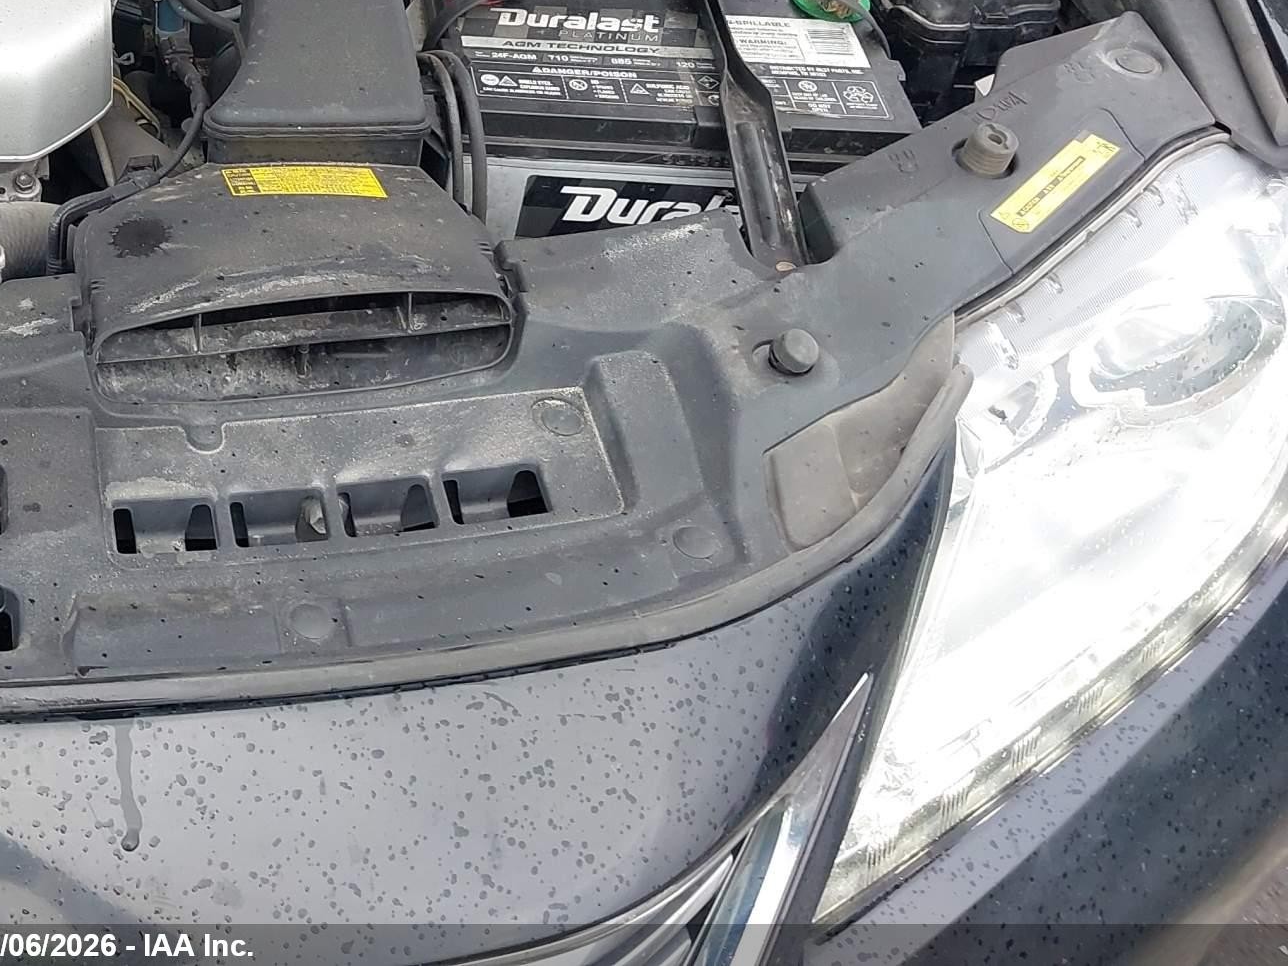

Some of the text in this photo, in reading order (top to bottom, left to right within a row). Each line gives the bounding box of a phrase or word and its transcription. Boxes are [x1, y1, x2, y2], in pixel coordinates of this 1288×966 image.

[490, 7, 660, 32] Duralast
[558, 30, 659, 42] PLATINUM
[502, 40, 660, 54] AGM TECHNOLOGY
[491, 52, 537, 60] 24F-AGM
[675, 61, 695, 69] 120
